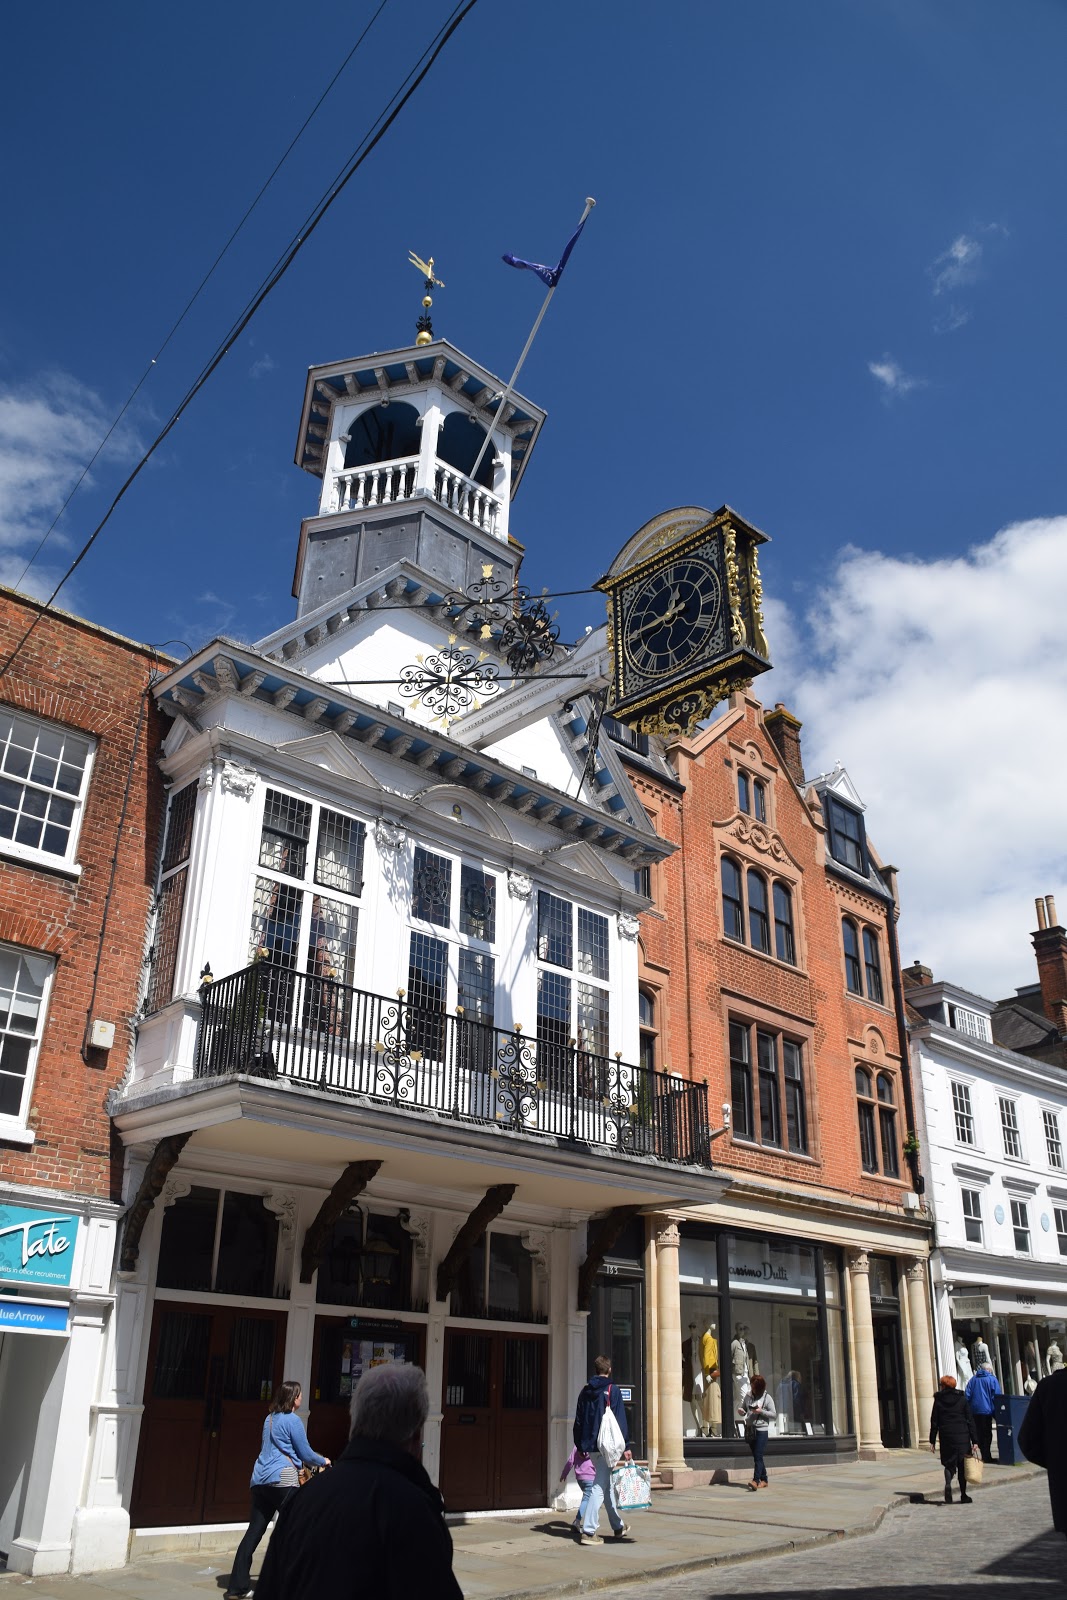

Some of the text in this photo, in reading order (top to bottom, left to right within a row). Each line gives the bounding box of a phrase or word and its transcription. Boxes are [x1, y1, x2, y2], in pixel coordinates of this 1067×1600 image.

[668, 701, 697, 720] 1683
[0, 1216, 72, 1267] Tate
[18, 1268, 34, 1276] office
[34, 1270, 67, 1280] recruitment
[728, 1261, 789, 1281] assimo Dutti
[958, 1301, 985, 1310] HOBBS
[0, 1309, 45, 1322] lueArrow
